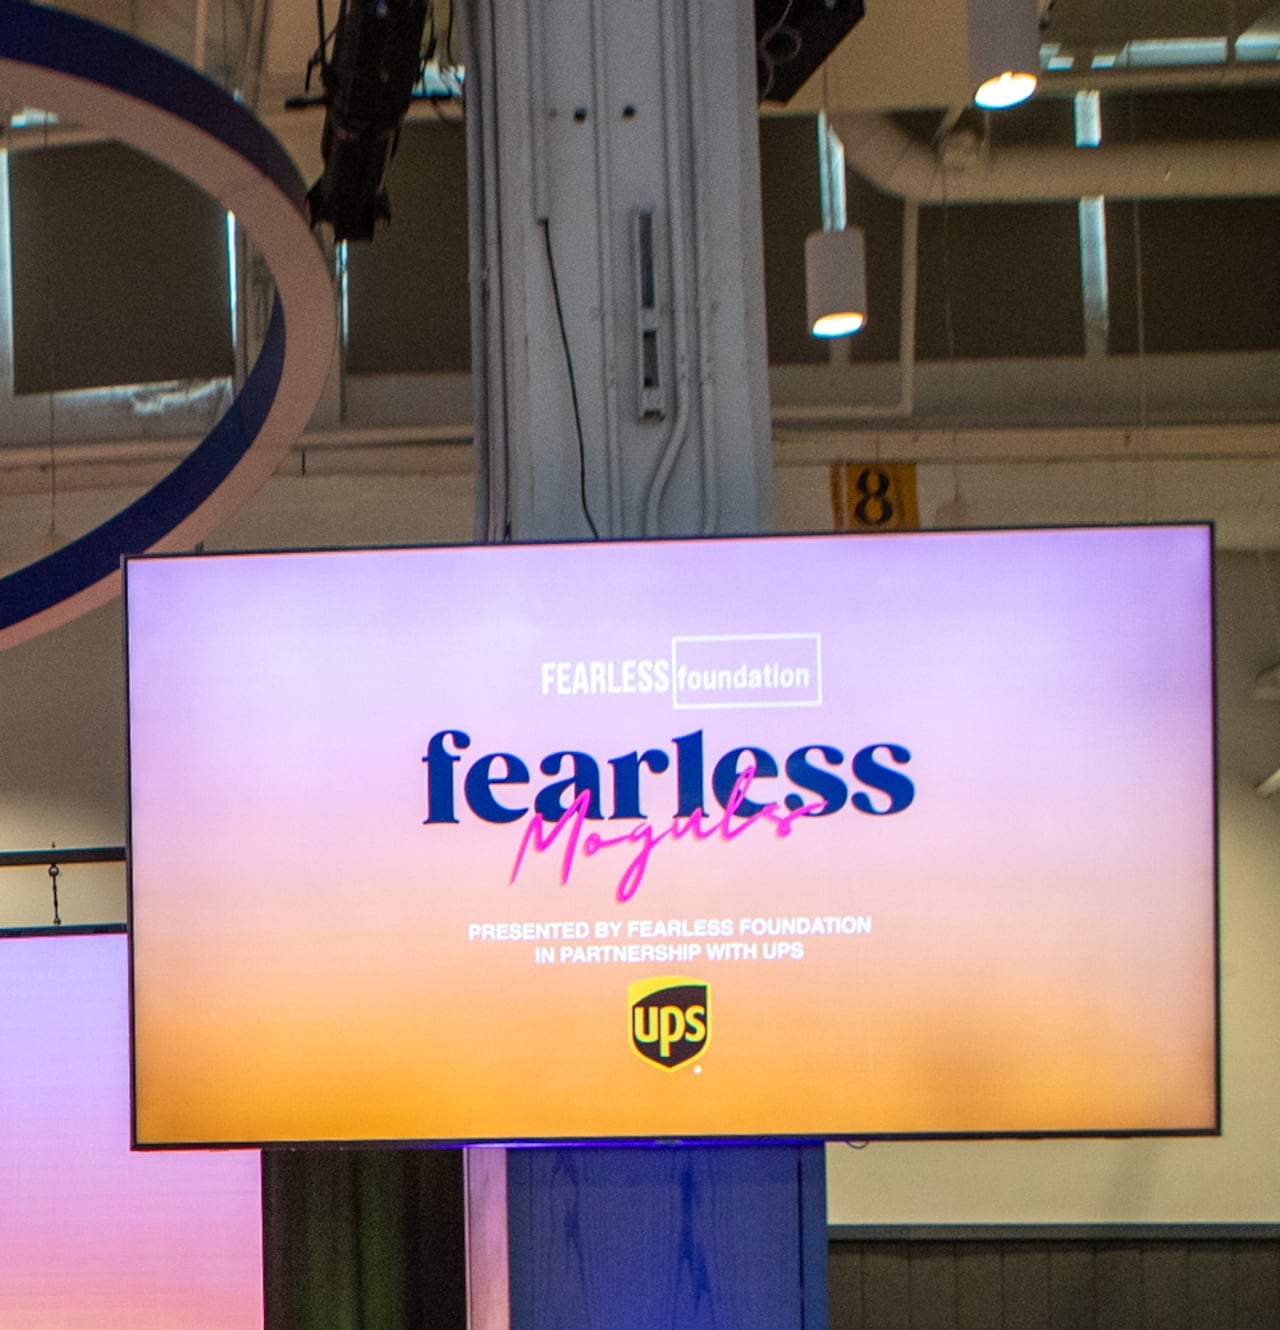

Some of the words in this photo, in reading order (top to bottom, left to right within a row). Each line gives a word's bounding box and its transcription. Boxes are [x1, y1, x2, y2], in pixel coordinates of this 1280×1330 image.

[855, 468, 893, 526] 8
[541, 659, 670, 695] FEARLESS
[676, 663, 810, 691] foundation
[422, 728, 915, 825] fearless
[509, 765, 828, 904] Moguls
[468, 921, 590, 941] PRESENTED
[594, 920, 622, 938] BY
[627, 918, 735, 938] FEARLESS
[739, 916, 872, 936] FOUNDATION
[534, 946, 556, 963] IN
[560, 944, 702, 963] PARTNERSHIP
[706, 942, 758, 961] WITH
[762, 941, 804, 960] UPS
[634, 1005, 706, 1057] ups
